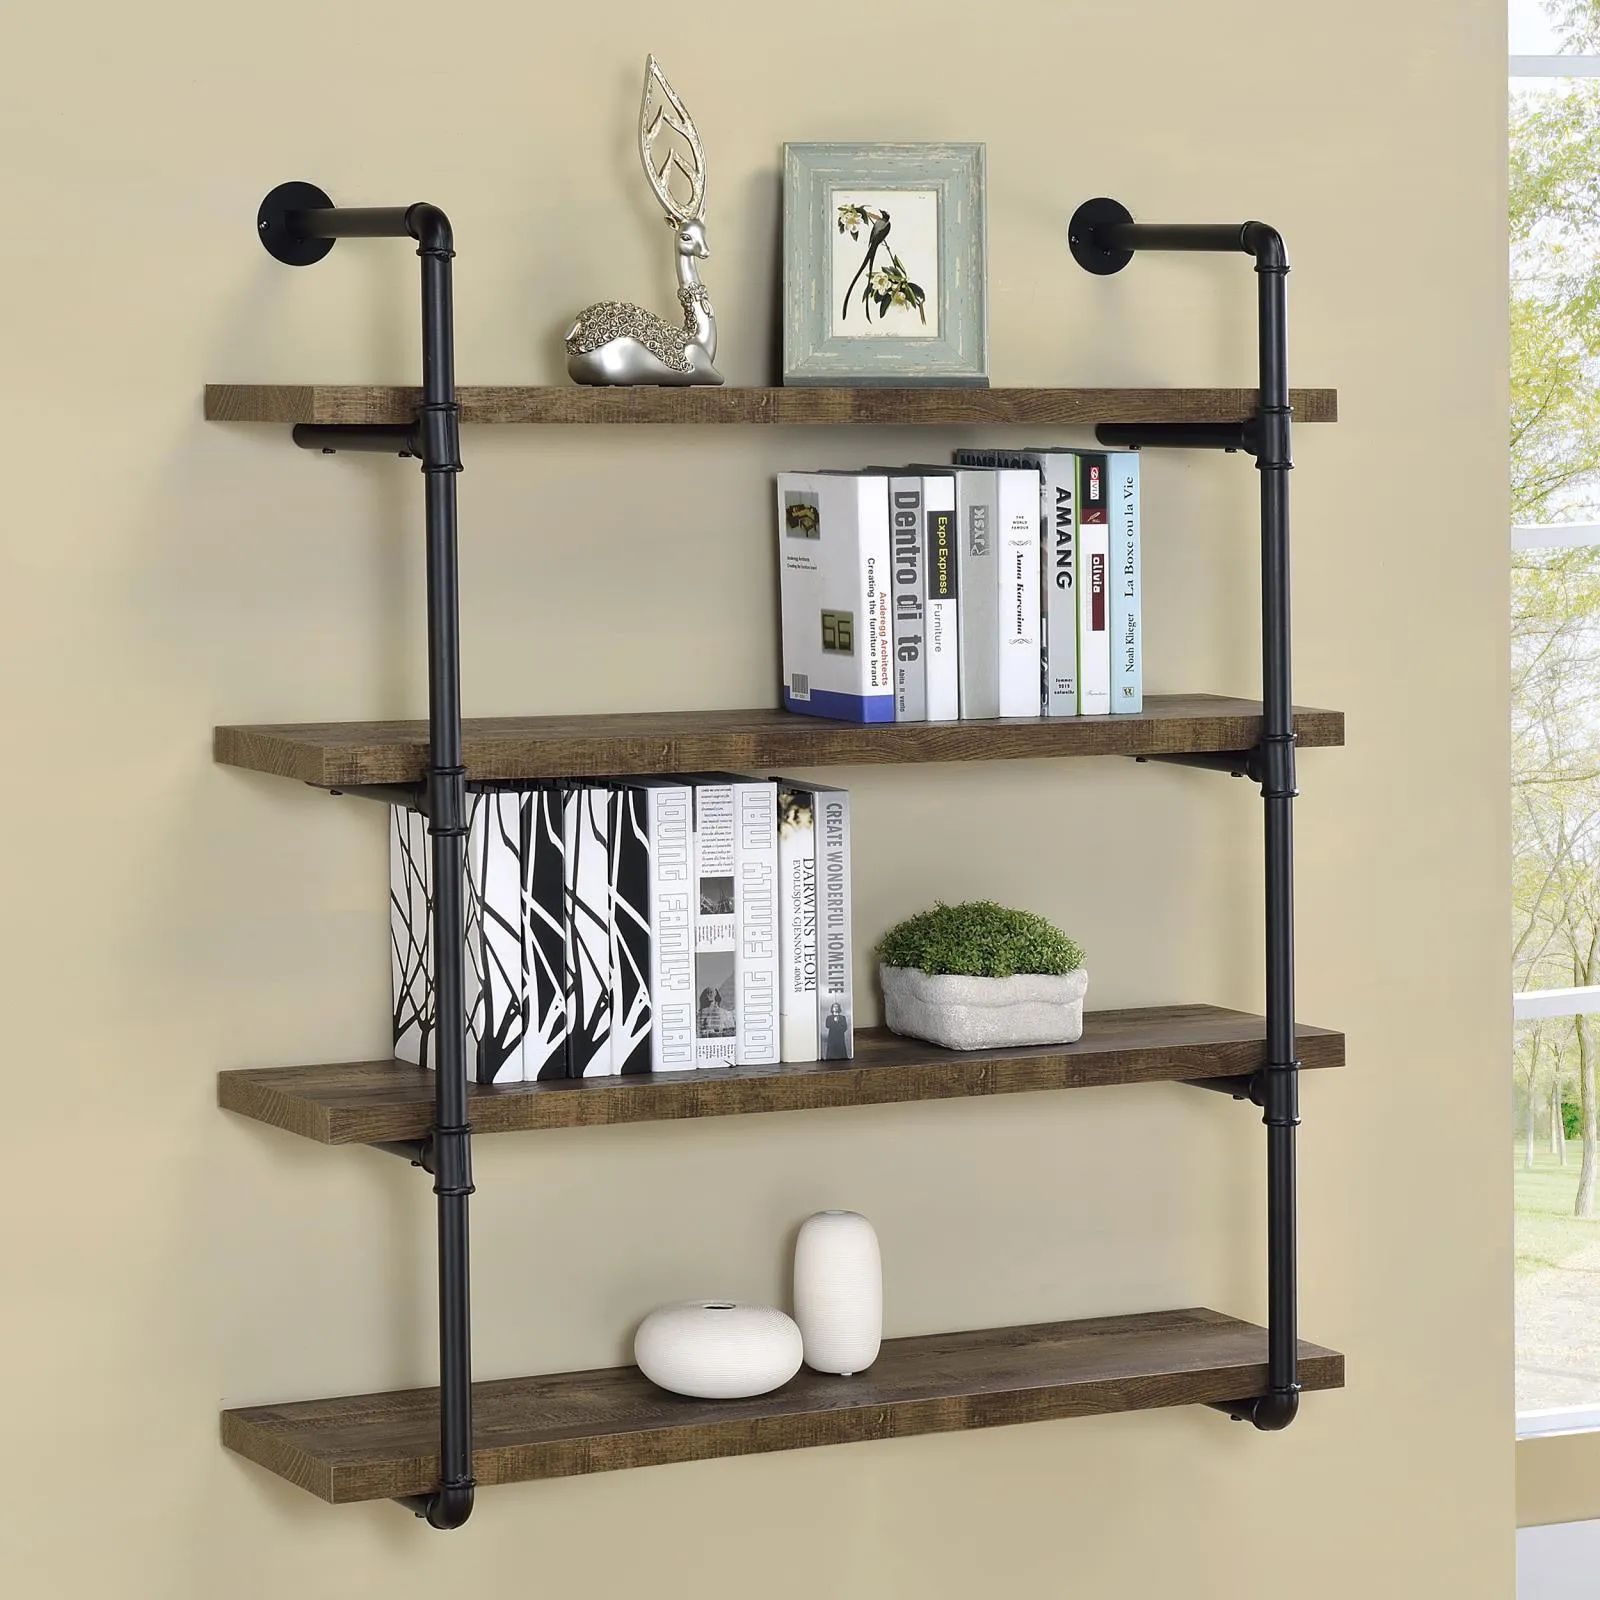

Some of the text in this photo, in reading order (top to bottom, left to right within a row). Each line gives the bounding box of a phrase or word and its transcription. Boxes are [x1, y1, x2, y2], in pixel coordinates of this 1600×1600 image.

[938, 516, 948, 594] Expo Express
[975, 507, 986, 545] JYSK
[1056, 486, 1073, 590] AMANG
[1124, 477, 1134, 597] La Boxe ou la Vie
[867, 558, 875, 597] Creating
[894, 492, 922, 662] Dentro di te
[1016, 551, 1024, 635] Anna Karenina
[1092, 557, 1102, 593] olivia
[879, 592, 888, 686] Anderegg Architects
[934, 604, 942, 652] Furniture
[1126, 613, 1136, 672] Noah Klieger
[793, 860, 801, 913] EVOLUSJON
[802, 858, 816, 992] DARWINS TEORI
[826, 802, 844, 994] CREATE WONDERFUL HOMELIFE
[659, 893, 689, 990] FAMILY
[661, 1003, 692, 1063] MAN
